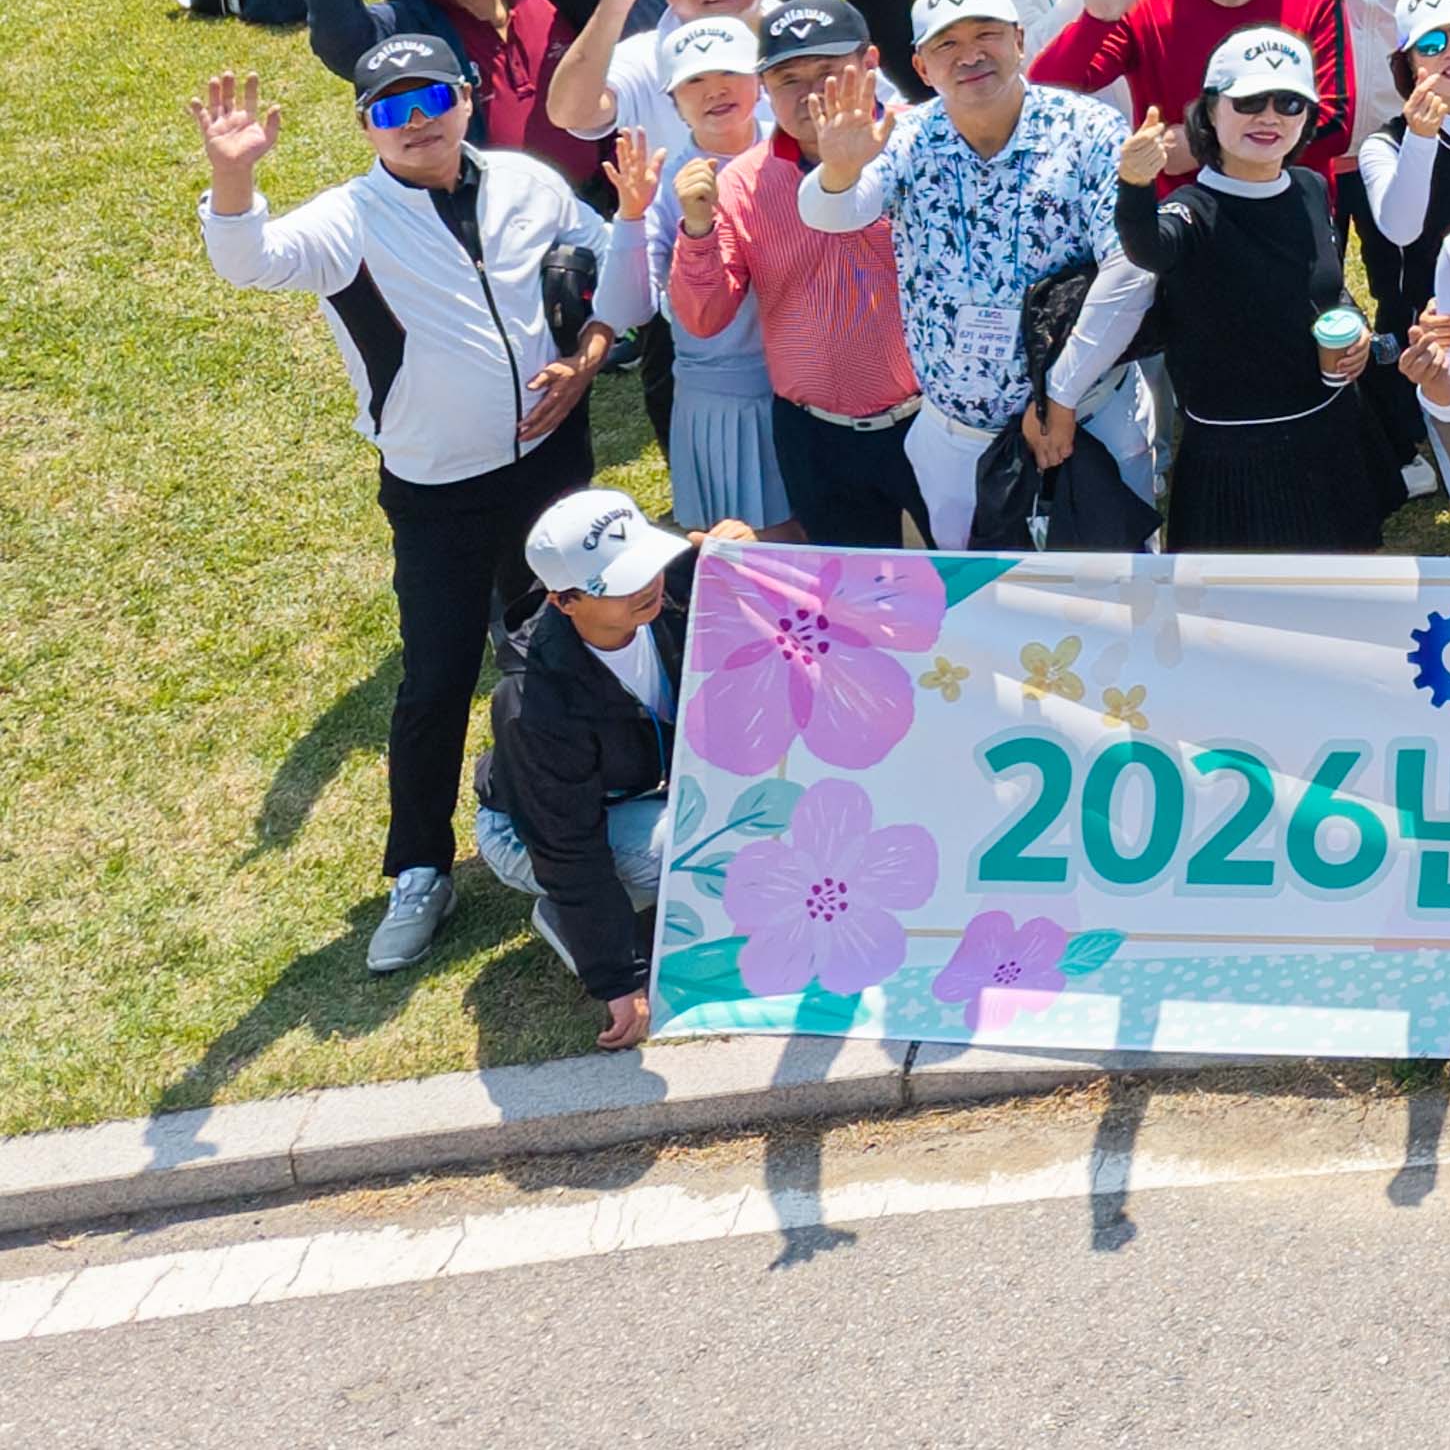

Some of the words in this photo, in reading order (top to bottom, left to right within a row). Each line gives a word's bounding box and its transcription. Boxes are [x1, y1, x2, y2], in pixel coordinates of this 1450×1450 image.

[770, 9, 833, 37] Callaway
[676, 27, 733, 54] Callaway
[1244, 43, 1300, 65] Callaway
[369, 42, 431, 71] Callaway
[584, 507, 633, 550] Callaway
